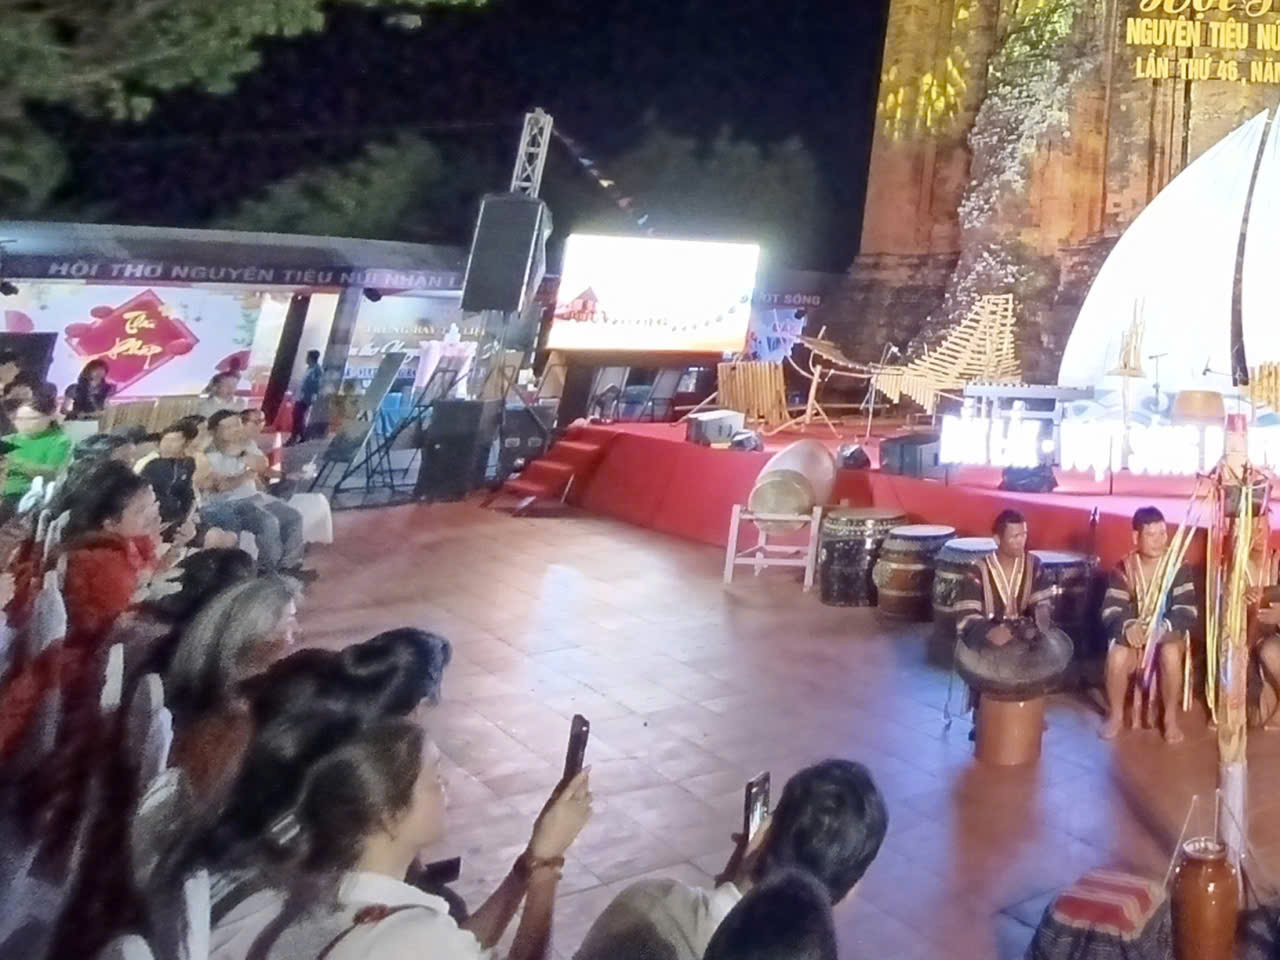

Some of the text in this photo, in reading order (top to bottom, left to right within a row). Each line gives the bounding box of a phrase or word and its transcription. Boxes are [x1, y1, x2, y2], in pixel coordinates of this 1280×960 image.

[1126, 15, 1202, 47] NGUYÊN
[1209, 17, 1249, 50] TIÊU
[1178, 53, 1213, 80] THỨ
